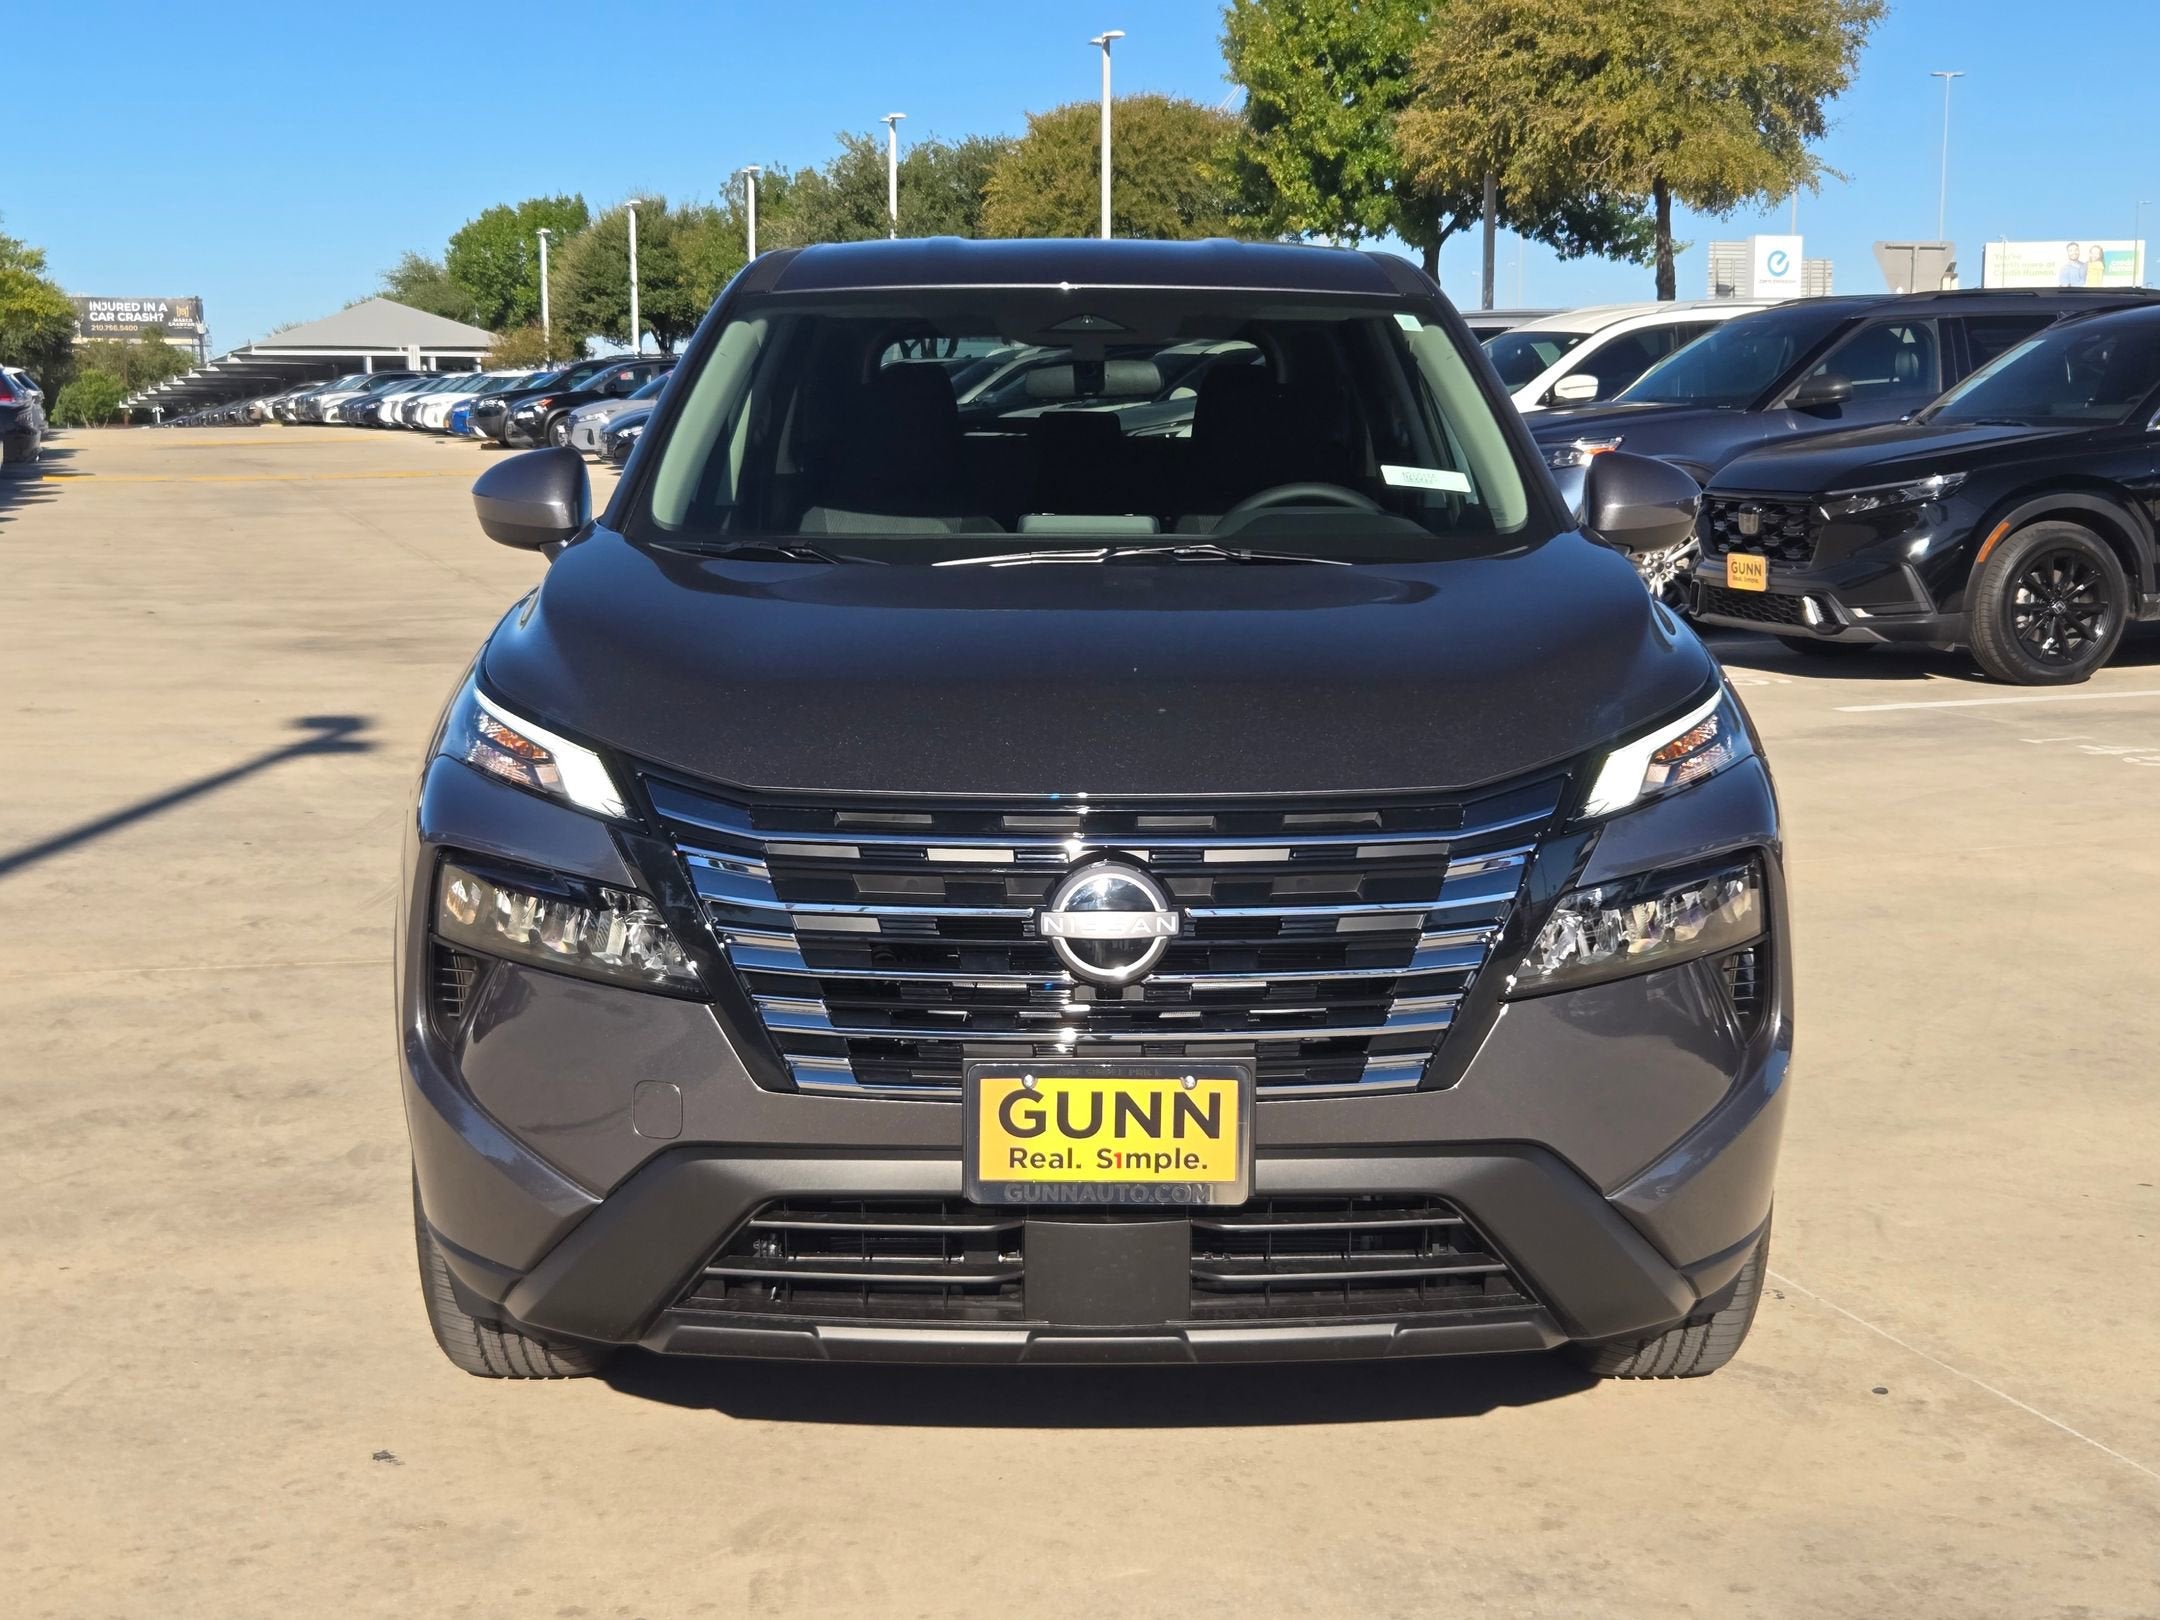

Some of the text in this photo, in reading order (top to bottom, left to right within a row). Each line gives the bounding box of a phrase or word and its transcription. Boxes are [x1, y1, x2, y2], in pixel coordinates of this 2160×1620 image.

[89, 300, 168, 312] INJURED IN A
[89, 311, 115, 321] CAR
[119, 312, 164, 322] CRASH?
[1730, 561, 1762, 576] GUNN
[998, 1088, 1221, 1139] GUNN
[1009, 1147, 1082, 1169] Real.
[1003, 1183, 1214, 1203] GUNNAUTO.COM
